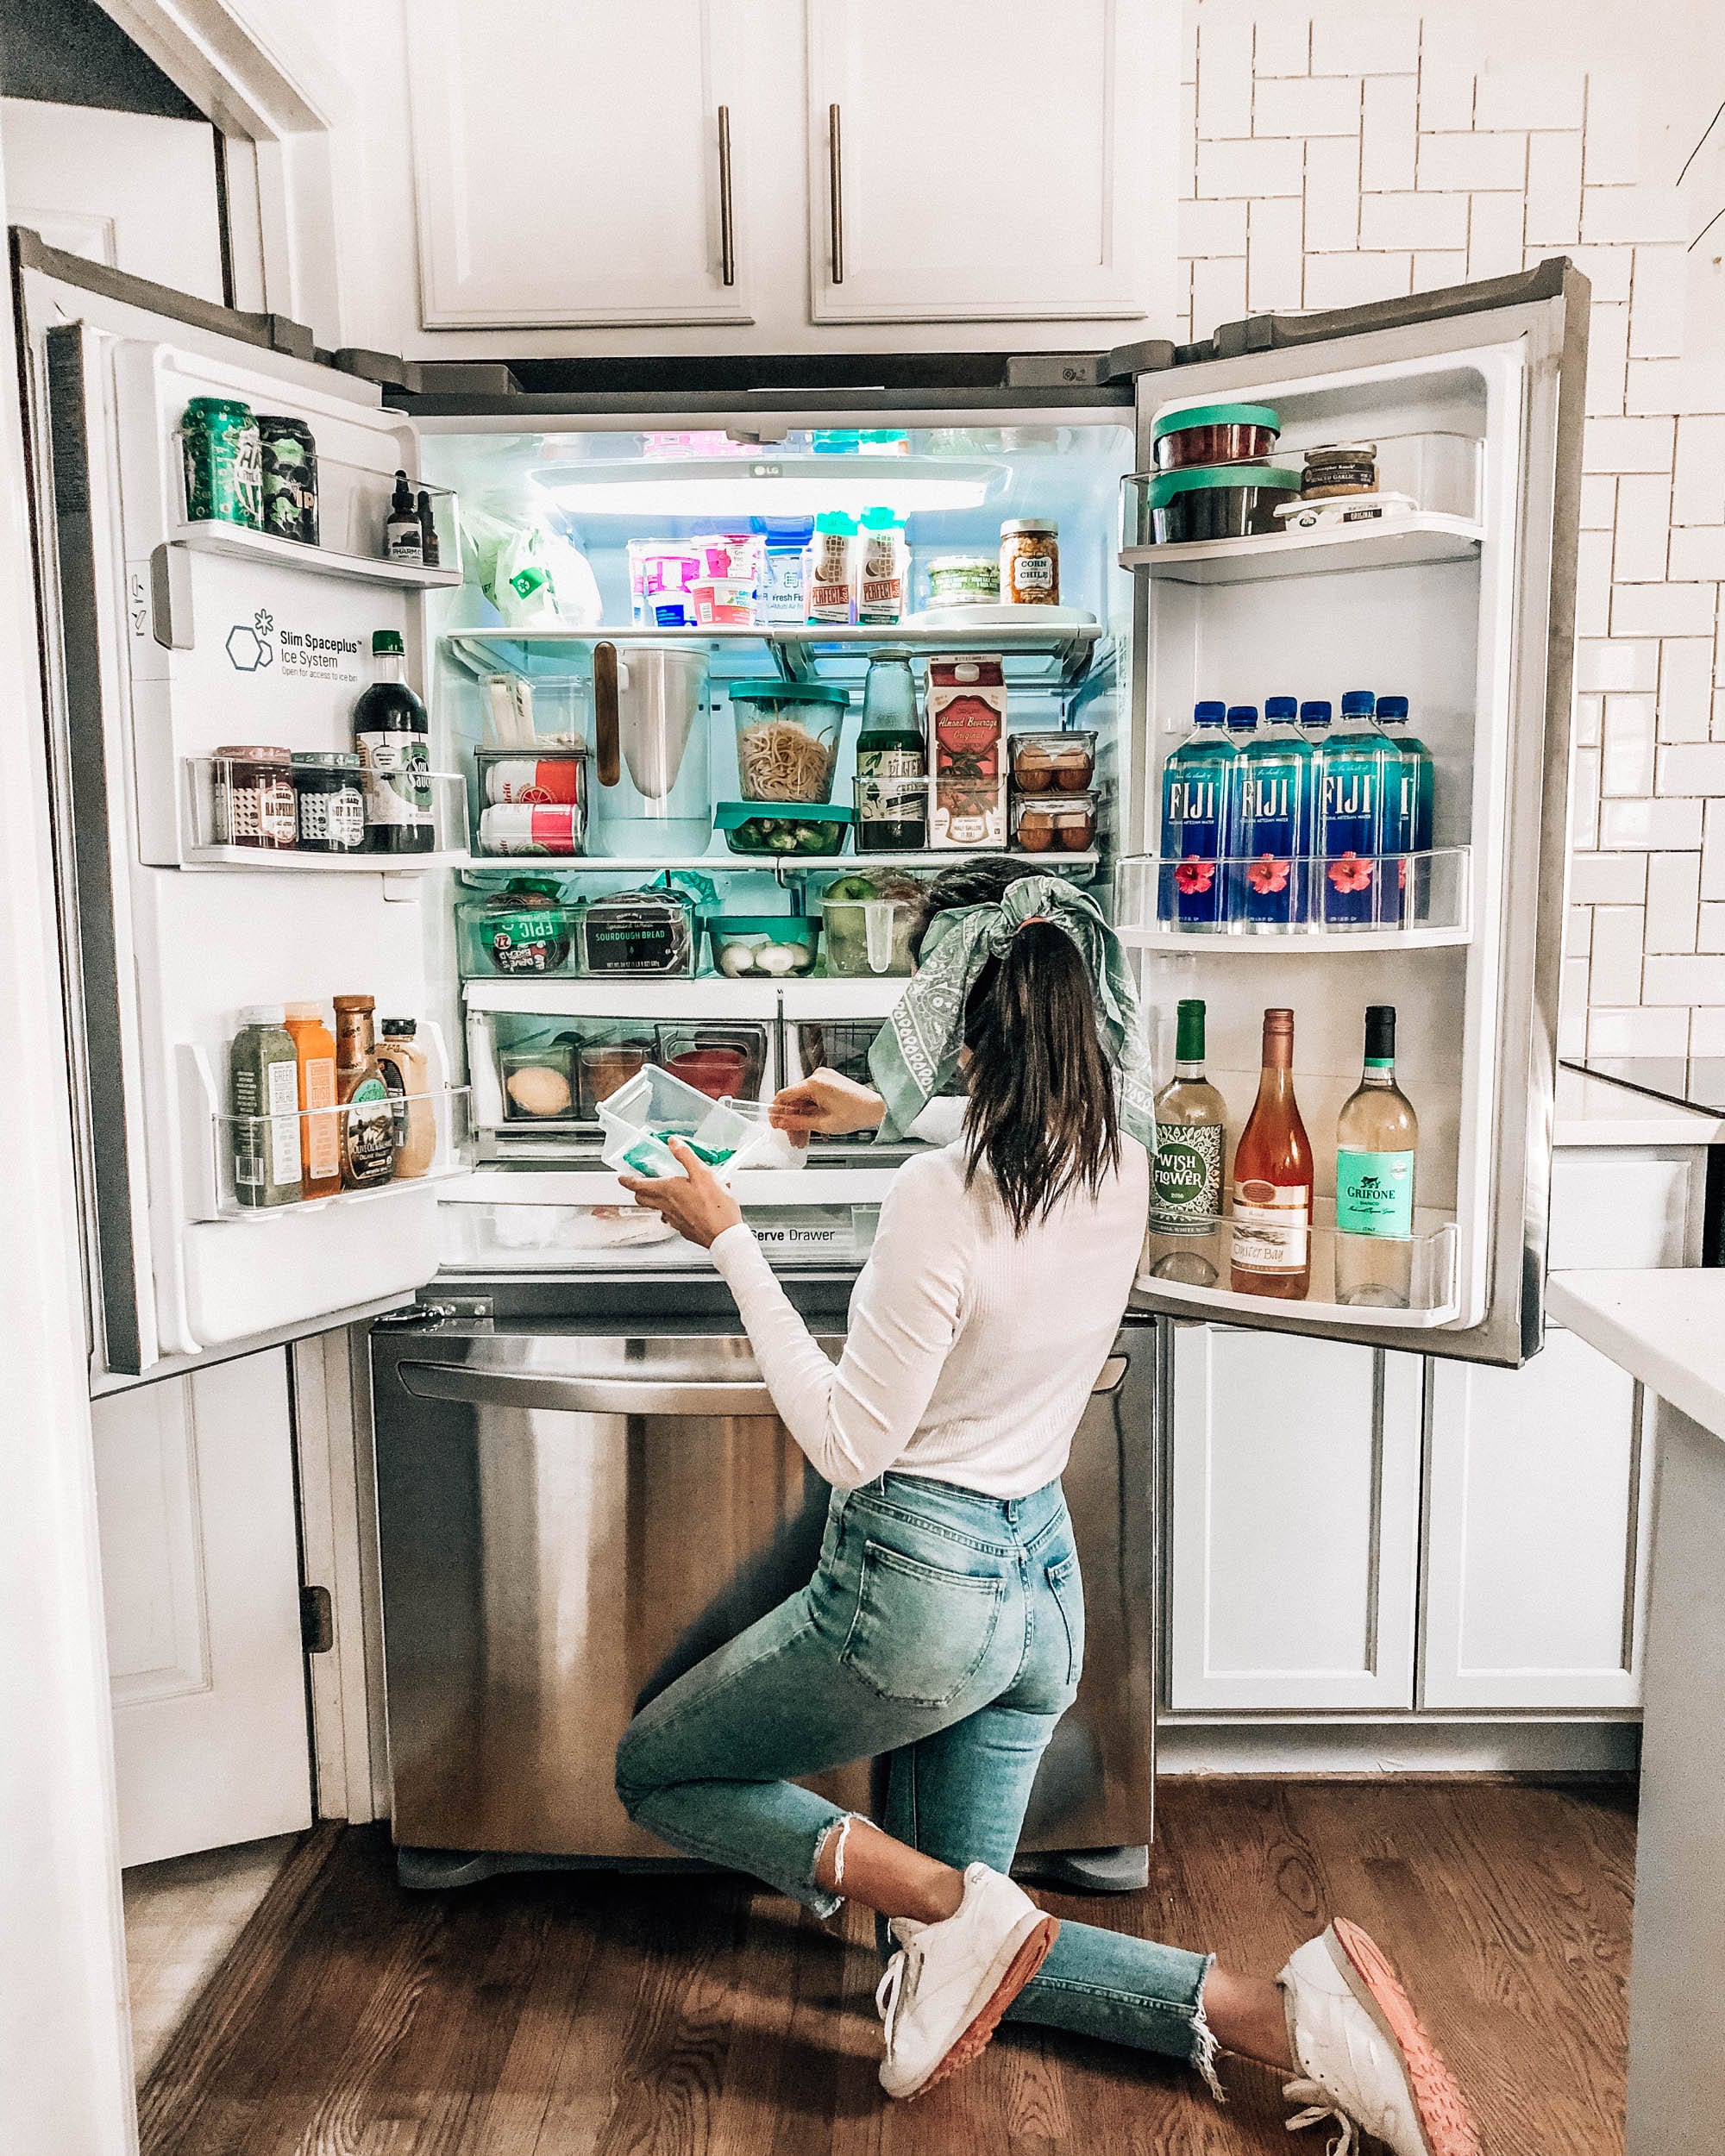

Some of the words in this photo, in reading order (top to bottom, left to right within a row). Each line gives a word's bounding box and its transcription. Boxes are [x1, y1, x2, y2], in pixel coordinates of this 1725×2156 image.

[1350, 511, 1374, 520] ORIGINAL
[812, 587, 838, 605] PERFECT
[863, 582, 891, 601] PERFECT
[280, 630, 304, 647] Slim
[281, 649, 298, 664] Ice
[299, 650, 338, 668] System
[282, 666, 298, 676] Open
[299, 667, 308, 677] for
[310, 670, 331, 680] access
[332, 672, 338, 680] to
[348, 674, 358, 683] bin
[938, 717, 965, 728] Almond
[968, 716, 997, 730] Beverage
[953, 730, 984, 740] Original
[1169, 782, 1214, 819] FIJI
[1241, 779, 1288, 817] FIJI
[1321, 774, 1371, 815] FIJI
[519, 923, 554, 937] EPIC
[595, 931, 641, 942] SOURDOUGH
[642, 930, 665, 939] BREAD
[499, 949, 531, 960] BREAD
[1159, 1154, 1196, 1172] WISH
[1155, 1169, 1202, 1188] FLOWER
[1347, 1186, 1396, 1200] GRIFONE
[789, 1229, 836, 1241] Drawer
[1264, 1248, 1283, 1262] Bay
